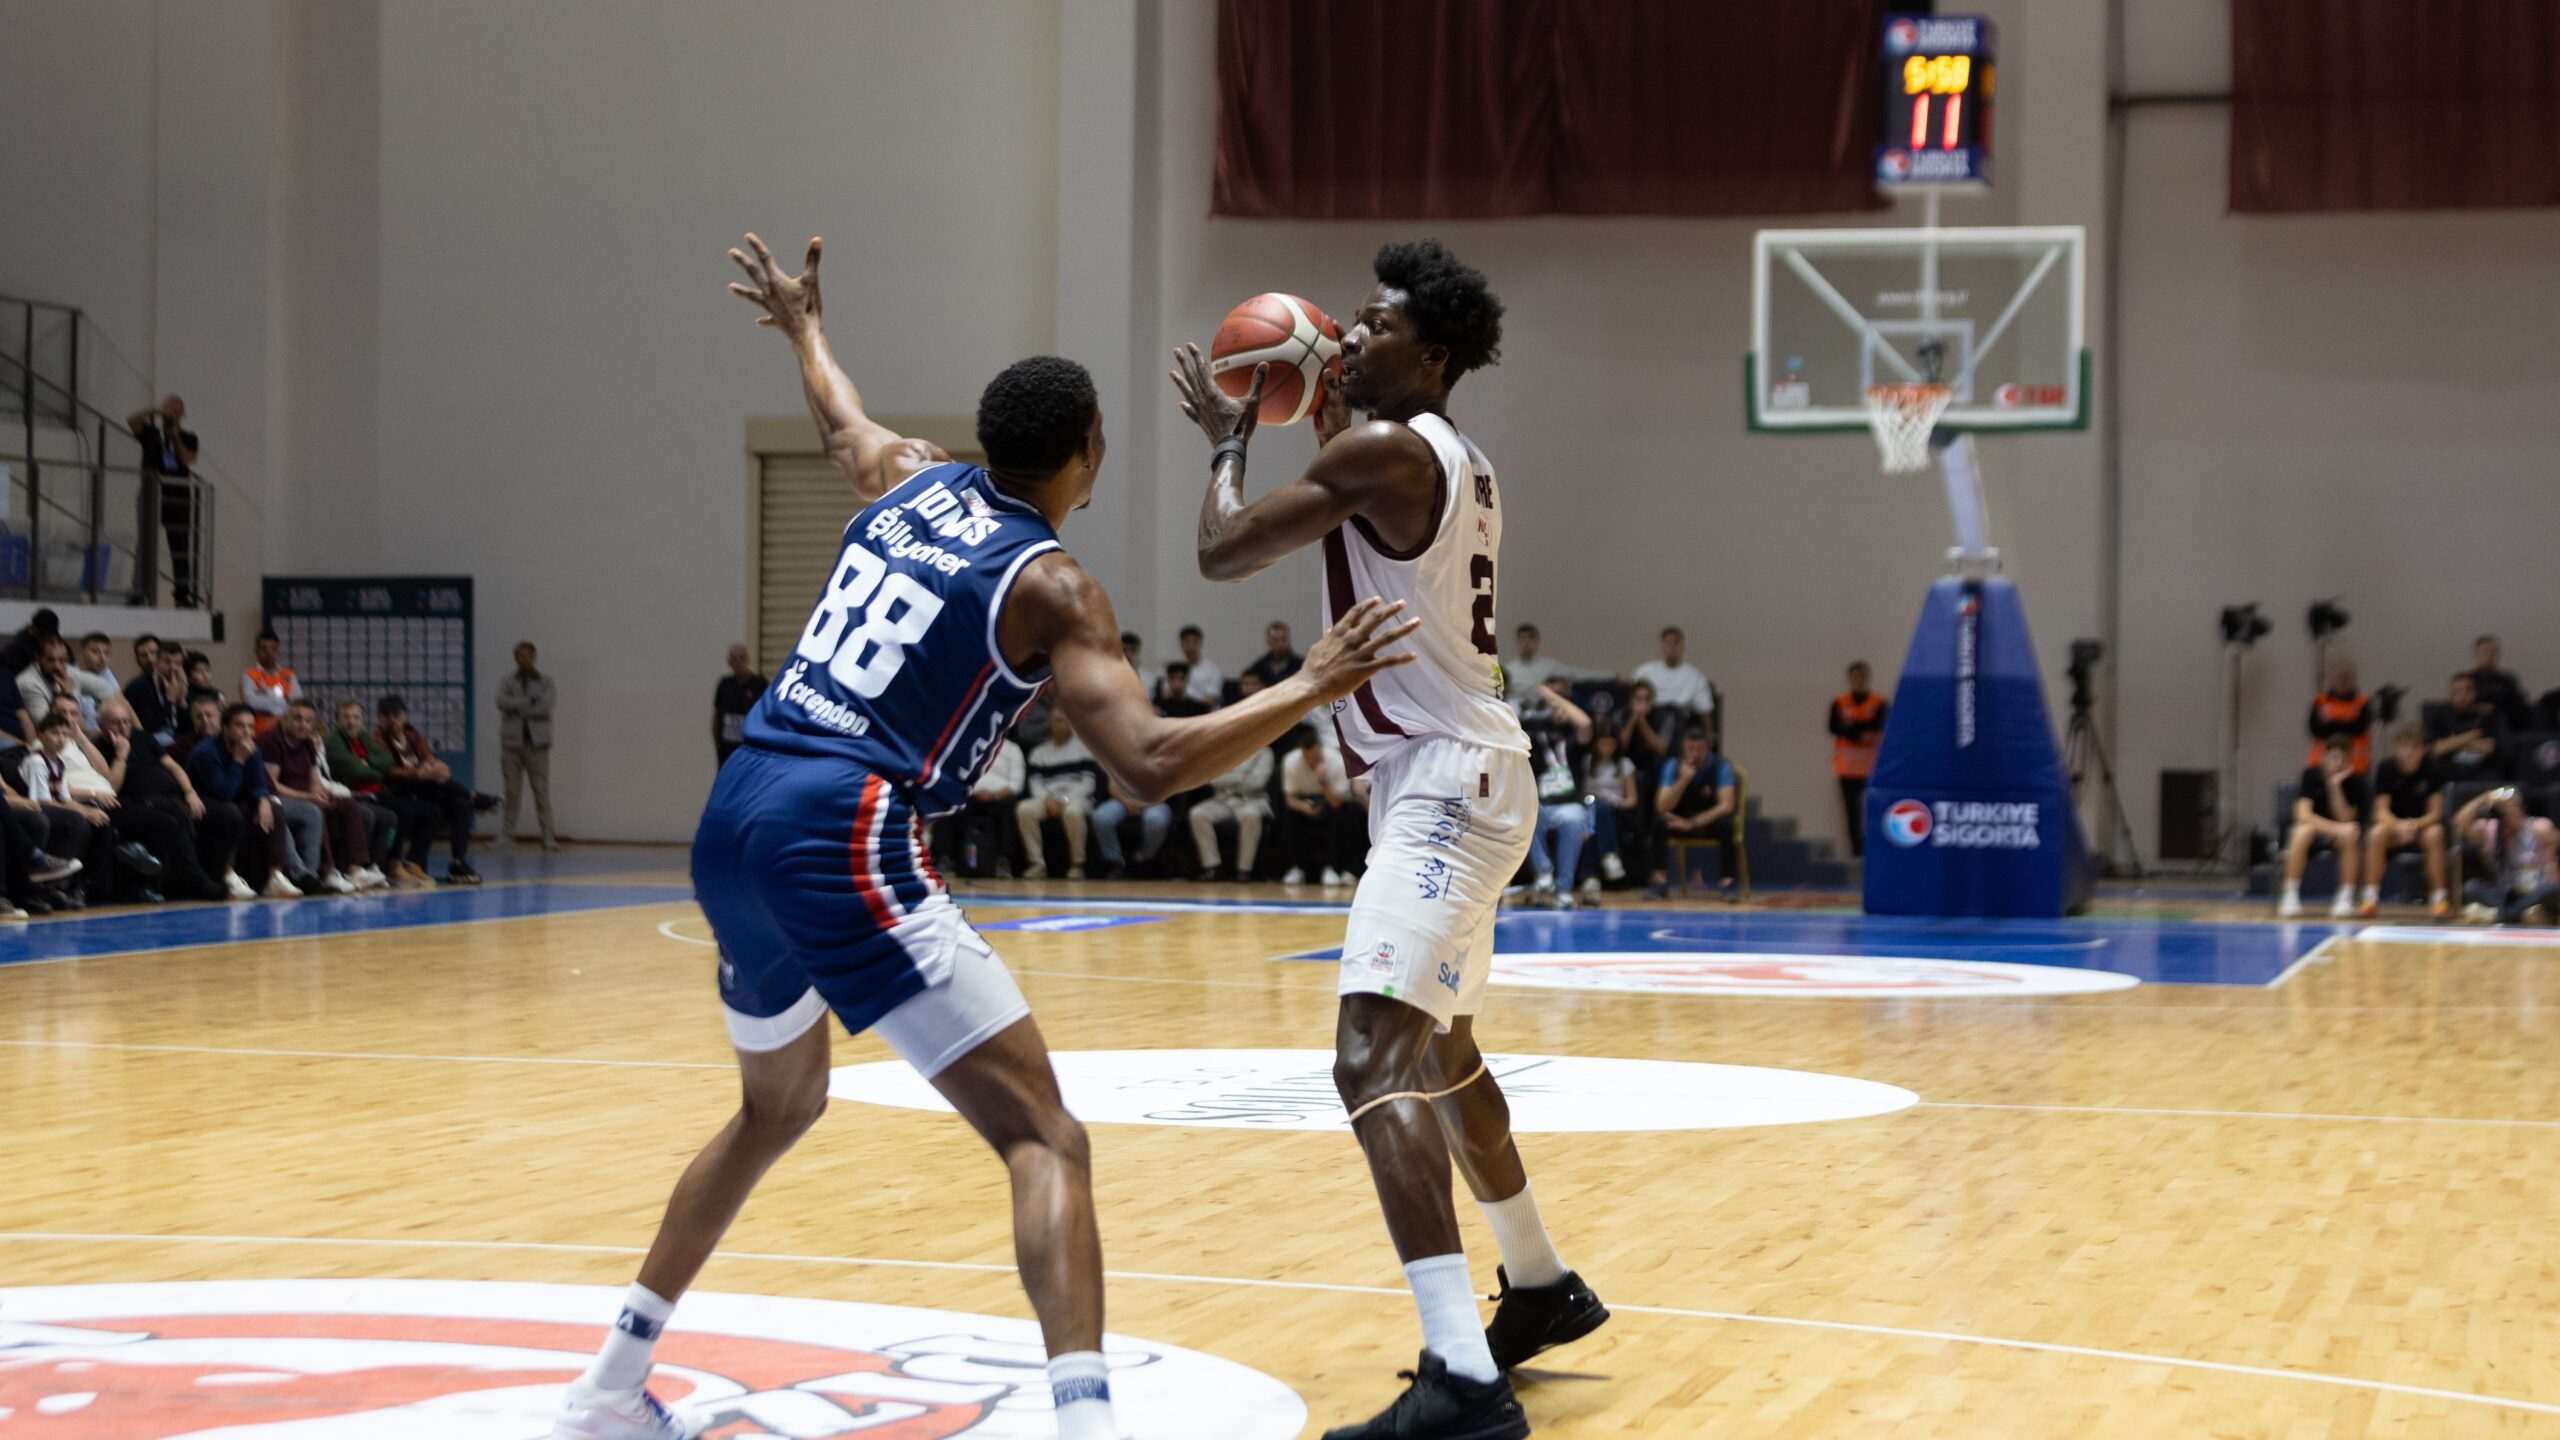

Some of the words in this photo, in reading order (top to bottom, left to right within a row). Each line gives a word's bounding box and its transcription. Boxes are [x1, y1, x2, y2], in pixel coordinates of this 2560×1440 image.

[1911, 93, 1961, 151] 11
[866, 507, 971, 576] Bilyoner
[796, 543, 945, 699] 88
